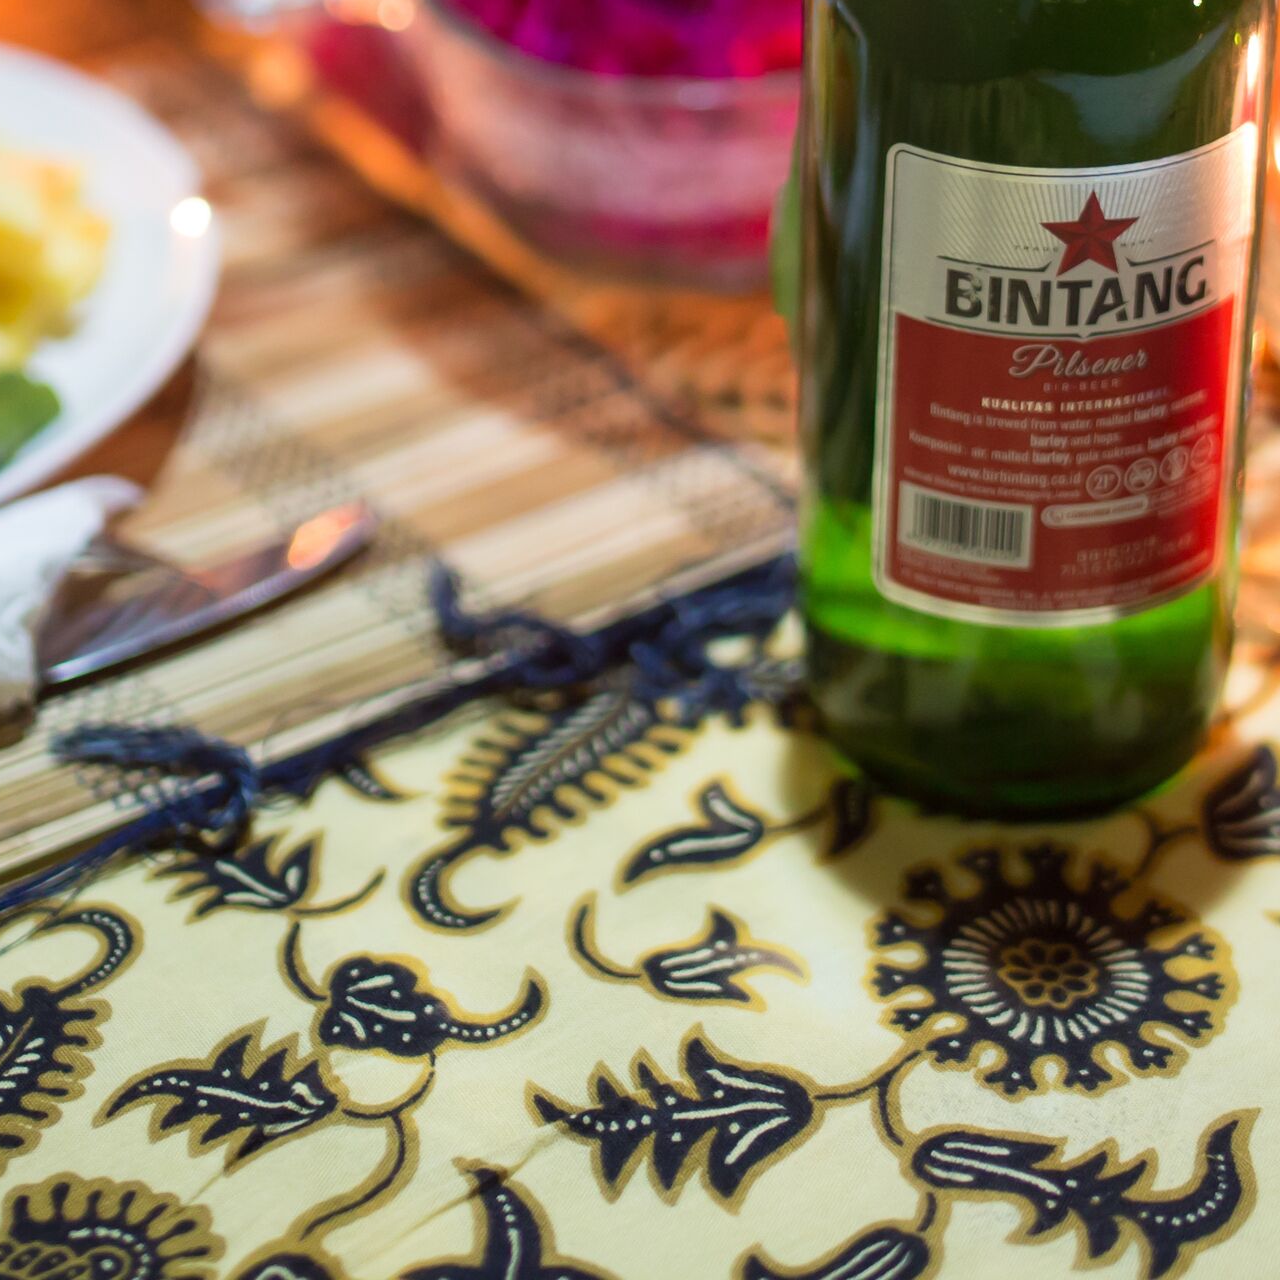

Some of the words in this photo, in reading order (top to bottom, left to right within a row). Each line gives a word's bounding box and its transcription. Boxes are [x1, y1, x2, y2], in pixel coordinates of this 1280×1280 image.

[944, 256, 1207, 326] BINTANG
[1008, 343, 1149, 378] Pilsener
[981, 396, 1055, 413] KUALITAS
[985, 415, 1028, 430] brewed
[1030, 417, 1057, 431] from
[1030, 433, 1069, 449] barley
[1070, 434, 1091, 447] and
